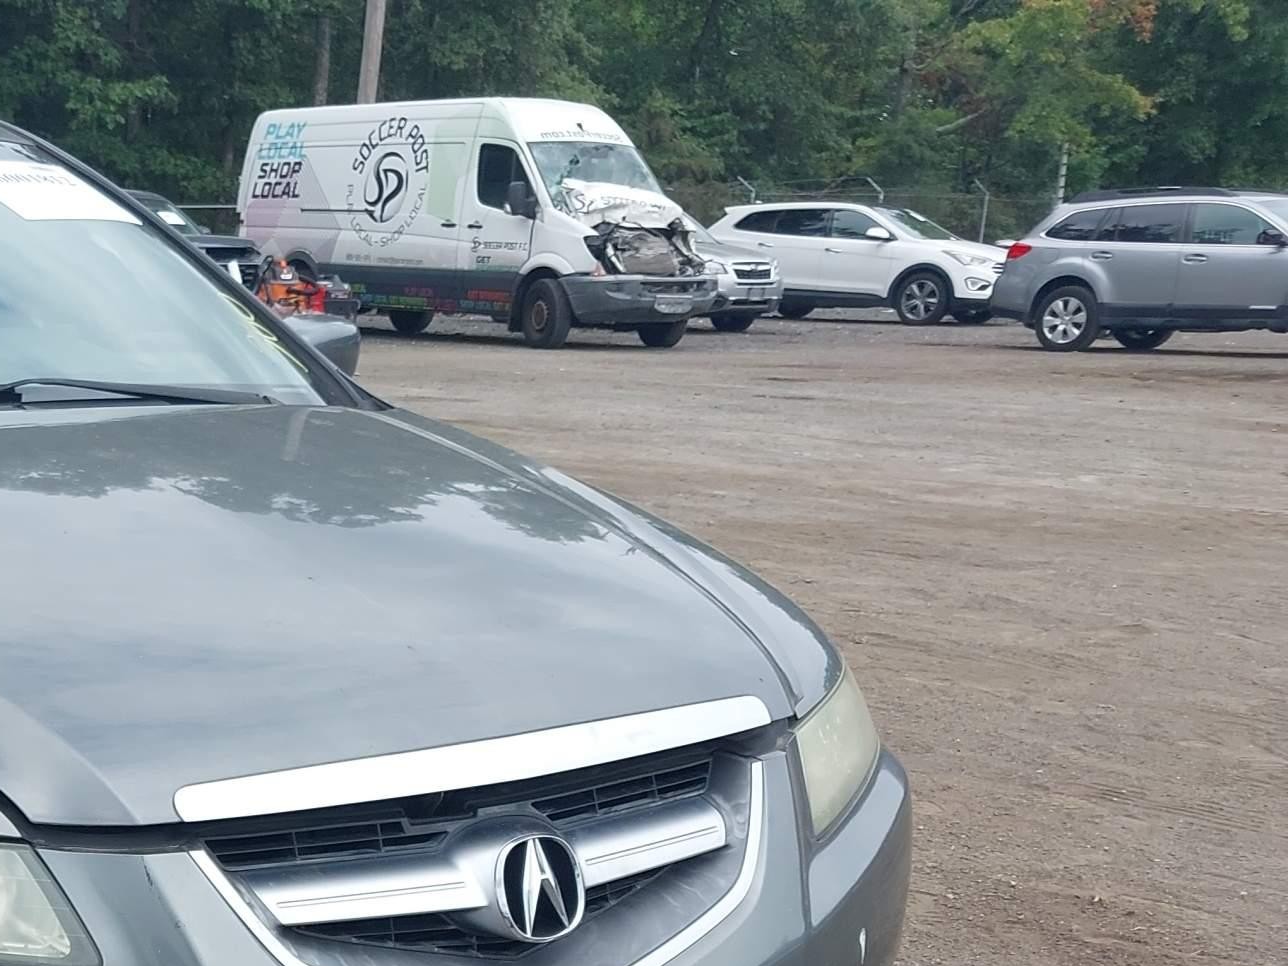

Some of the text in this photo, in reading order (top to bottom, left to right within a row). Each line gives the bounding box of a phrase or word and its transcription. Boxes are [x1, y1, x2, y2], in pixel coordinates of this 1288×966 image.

[263, 121, 307, 140] PLAY
[257, 142, 308, 160] LOCAL
[352, 116, 430, 175] SOCCER POST
[257, 161, 303, 180] SHOP
[251, 181, 301, 199] LOCAL
